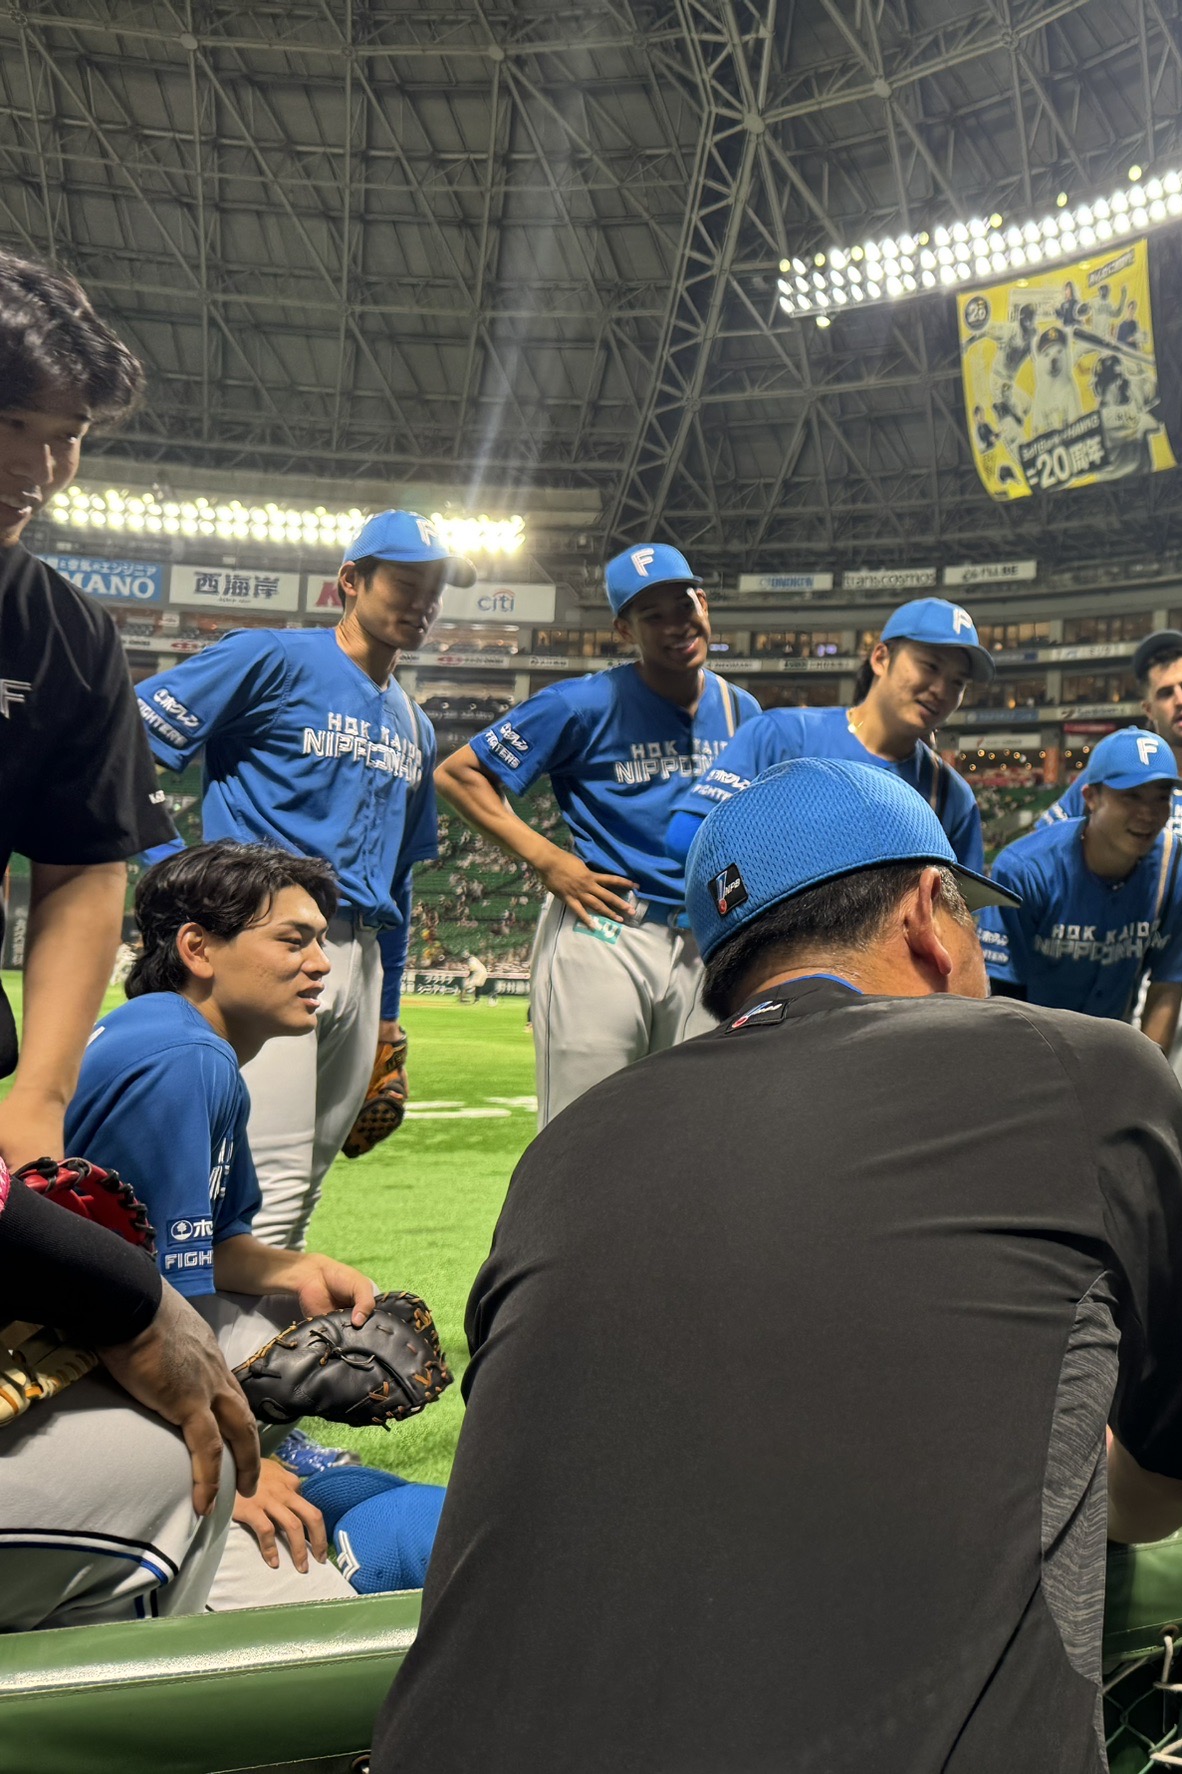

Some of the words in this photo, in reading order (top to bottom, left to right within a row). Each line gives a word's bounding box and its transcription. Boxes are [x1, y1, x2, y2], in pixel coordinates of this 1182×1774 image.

[630, 548, 655, 577] F
[194, 571, 280, 599] 西海岸
[477, 594, 515, 612] citi
[952, 607, 974, 635] F
[1136, 737, 1159, 765] F
[164, 1250, 214, 1270] FIGH
